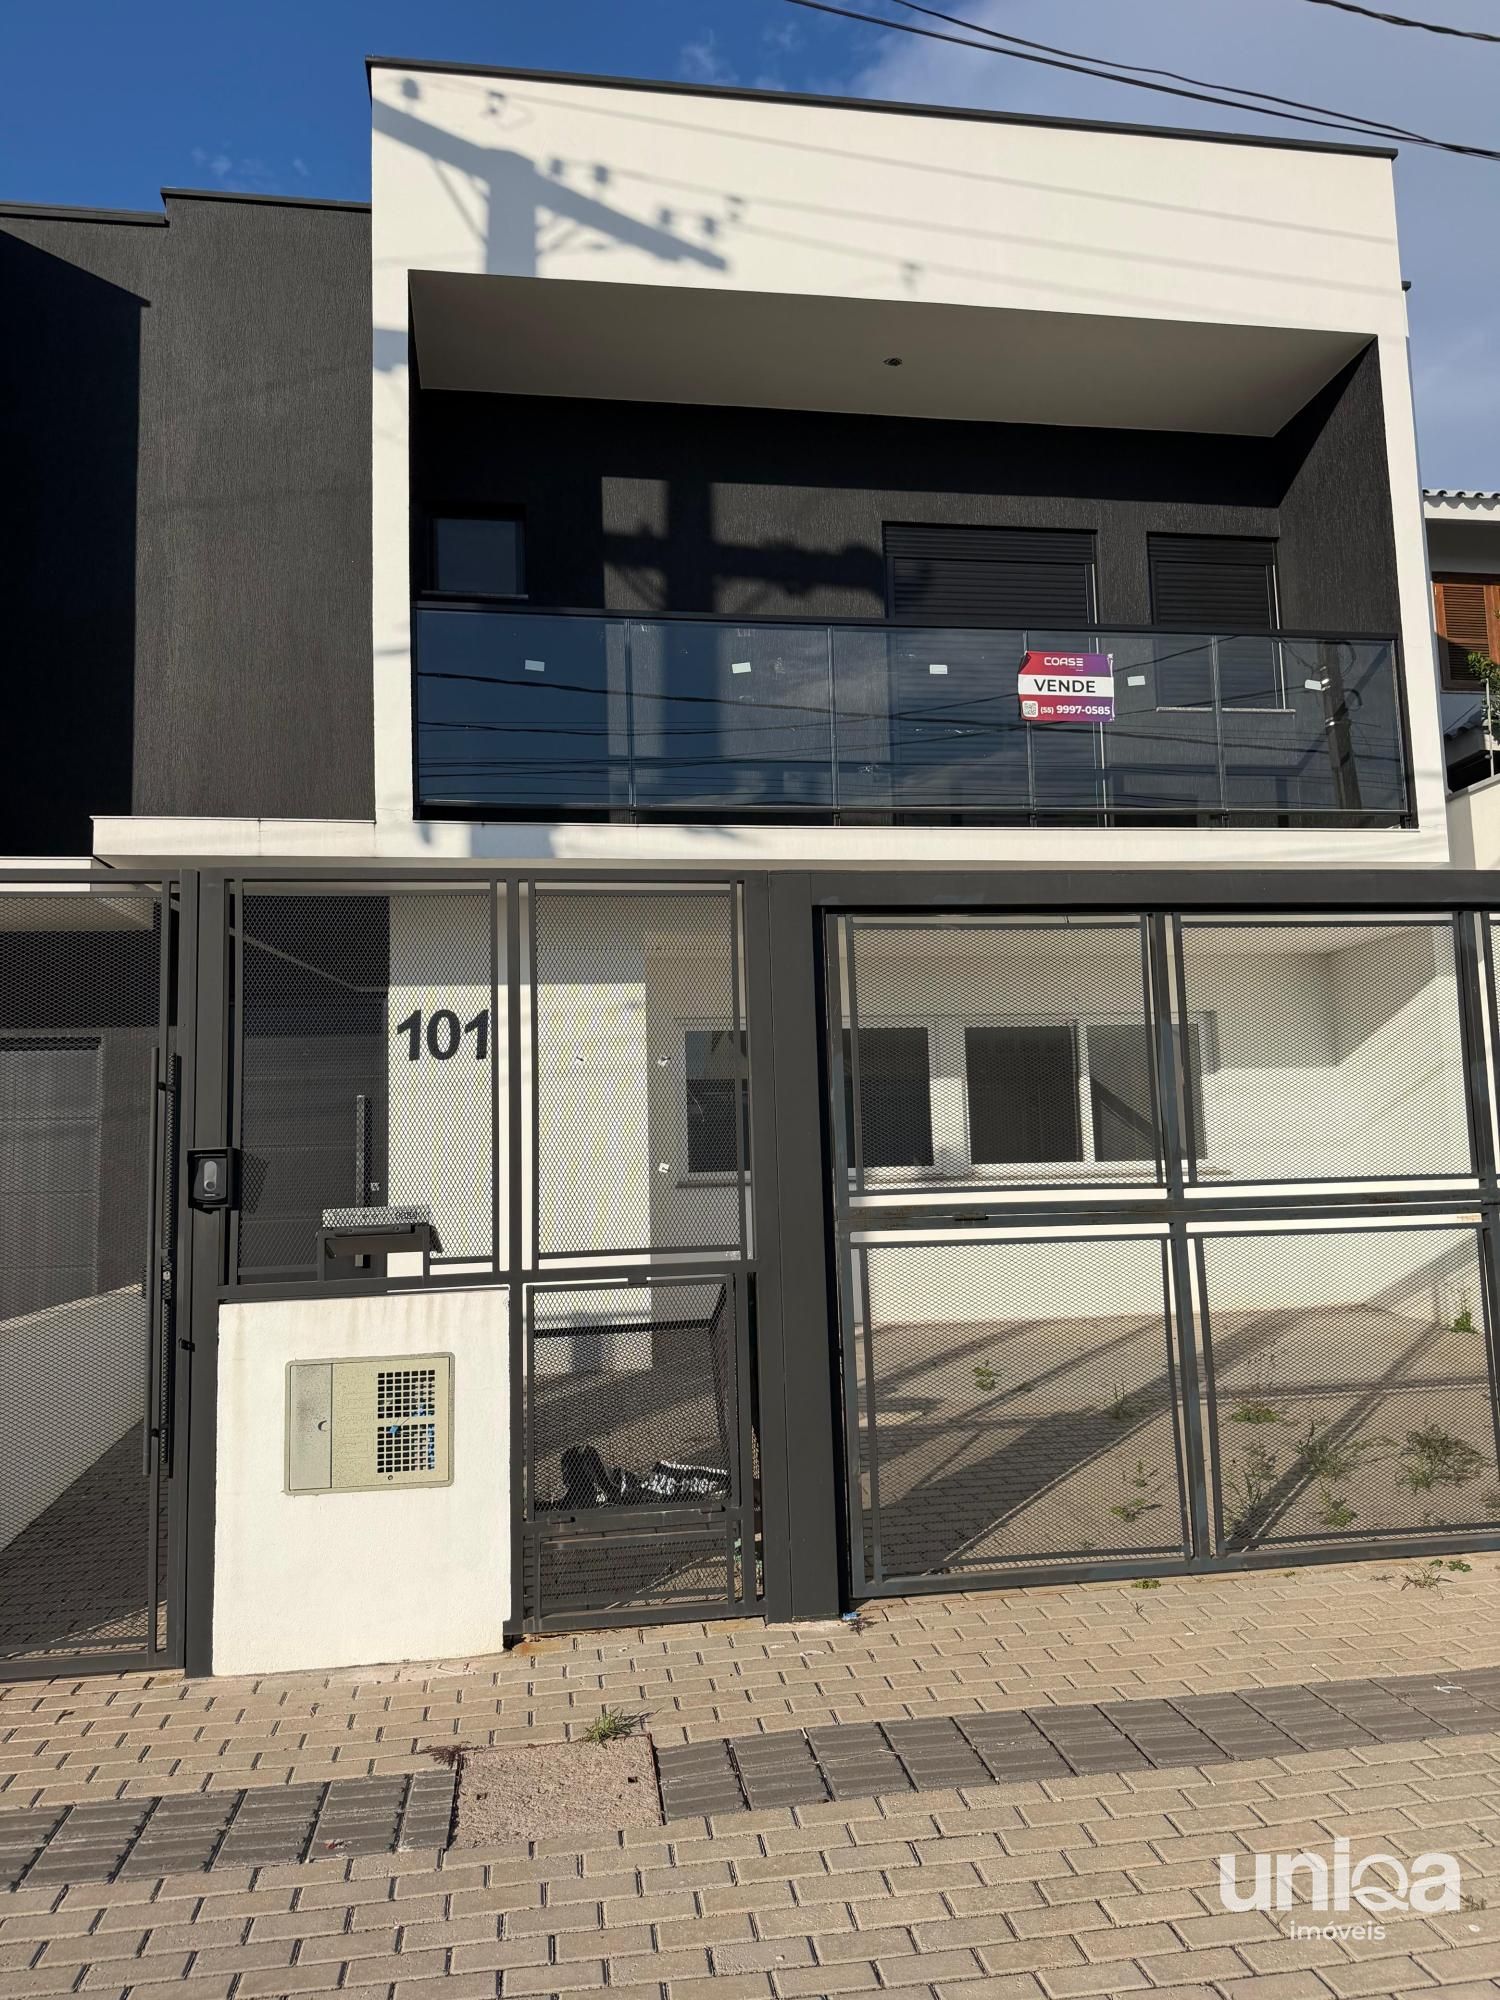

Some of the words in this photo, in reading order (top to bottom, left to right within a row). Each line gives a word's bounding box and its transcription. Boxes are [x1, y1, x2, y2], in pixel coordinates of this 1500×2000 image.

[1044, 657, 1084, 667] COASE
[1034, 678, 1096, 693] VENDE
[1040, 706, 1054, 714] (55)
[1056, 705, 1111, 715] 9997-0585
[396, 1009, 489, 1061] 101
